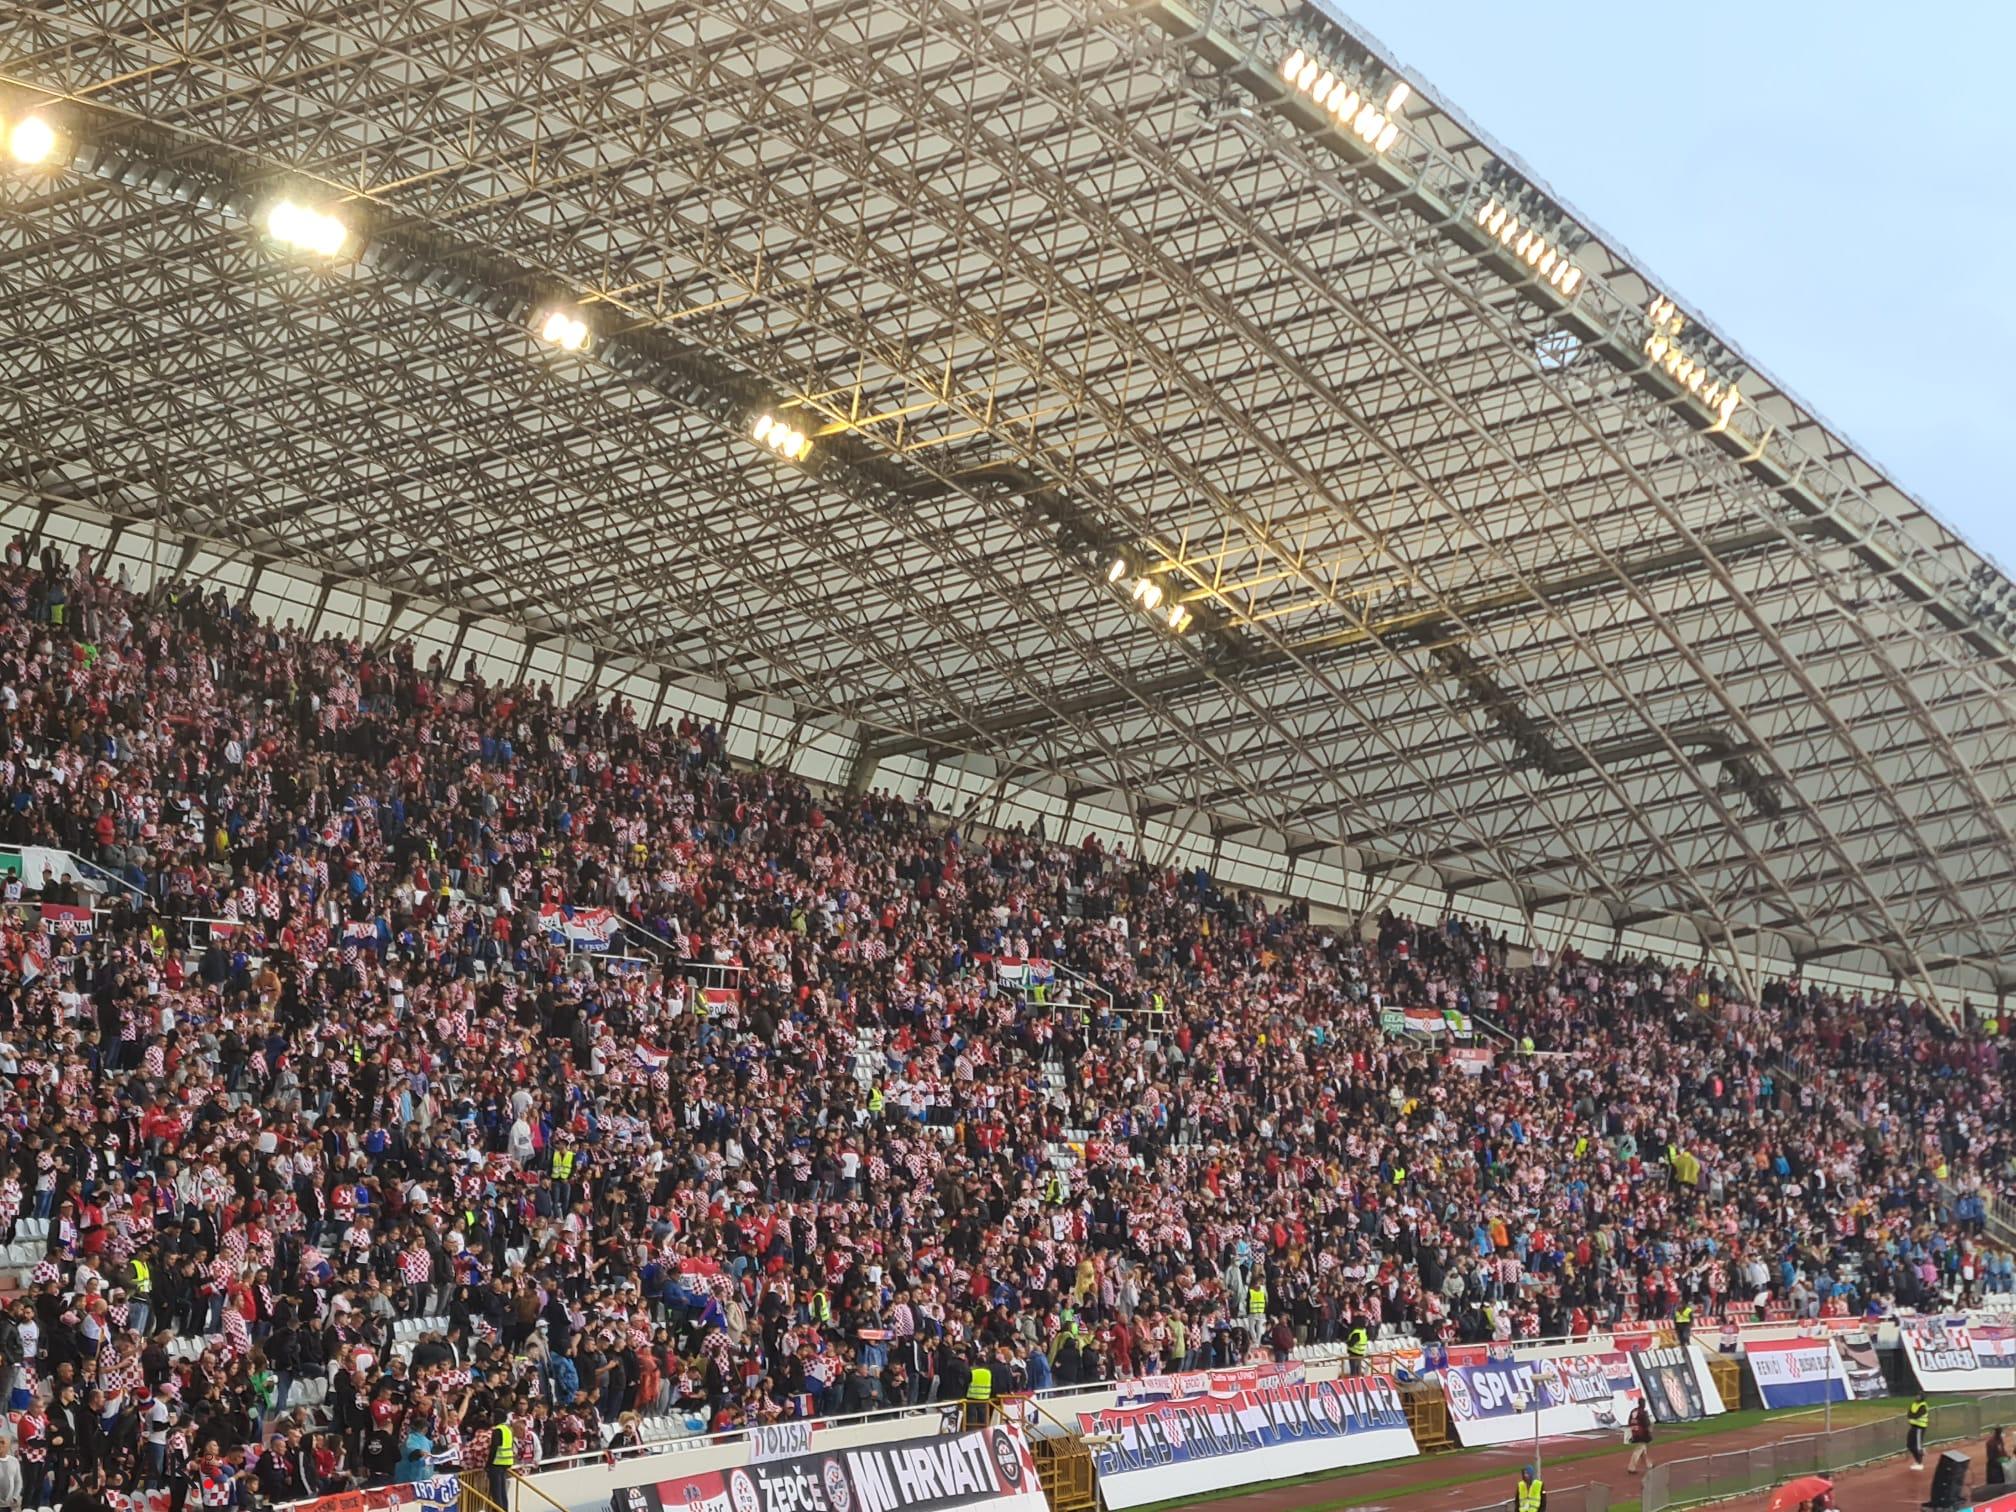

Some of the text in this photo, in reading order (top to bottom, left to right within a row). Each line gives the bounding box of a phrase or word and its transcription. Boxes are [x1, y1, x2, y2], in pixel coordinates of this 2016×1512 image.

[1917, 1350, 1976, 1370] ZAGREB
[1253, 1376, 1404, 1441] VUKOVAR
[1472, 1366, 1536, 1410] SPLIT
[757, 1424, 808, 1454] TOLISA
[757, 1465, 828, 1512] ŽEPČE
[846, 1432, 1001, 1512] MI HRVATI
